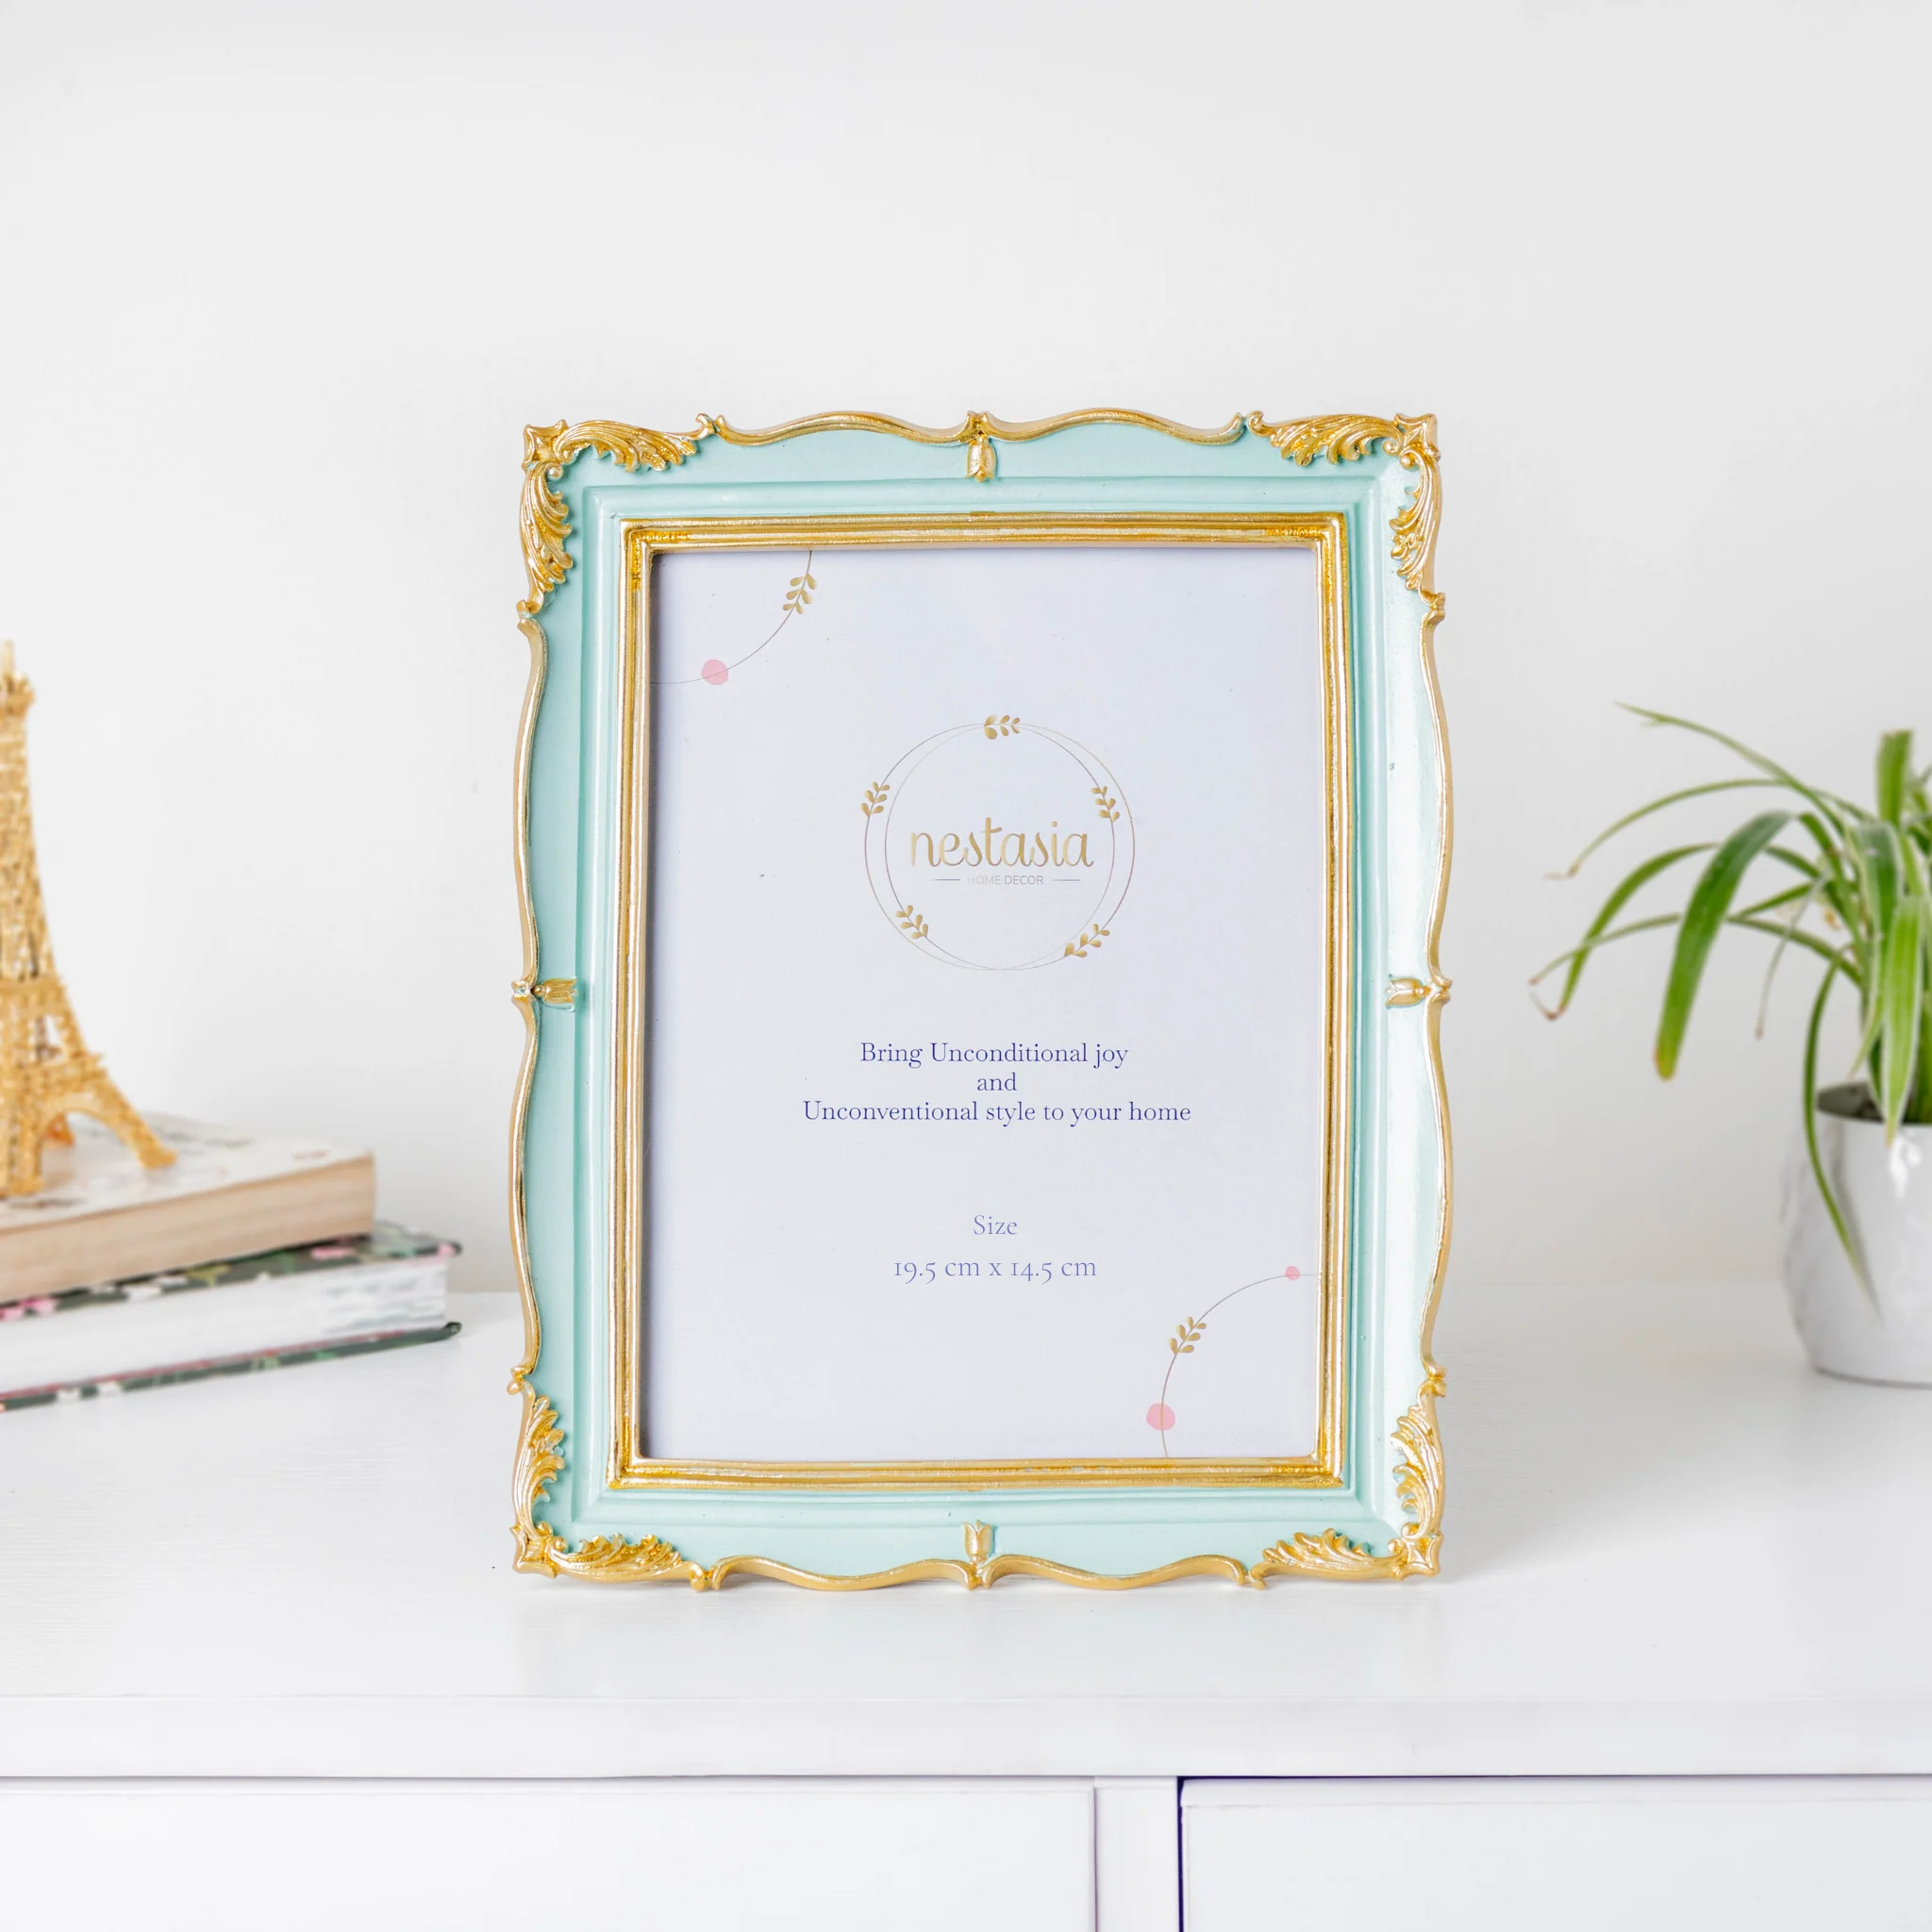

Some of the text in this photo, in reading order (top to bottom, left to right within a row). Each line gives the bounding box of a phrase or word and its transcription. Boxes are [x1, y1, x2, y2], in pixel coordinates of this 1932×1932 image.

[910, 817, 1094, 867] nestasia
[967, 874, 1044, 885] HOME DECOR
[860, 1042, 1129, 1069] Bring Unconditional joy
[976, 1072, 1018, 1091] and
[803, 1101, 1191, 1127] Unconventional style to your home
[973, 1214, 1018, 1236] Size
[893, 1261, 1097, 1285] 19.5 cm x 14.5 cm
